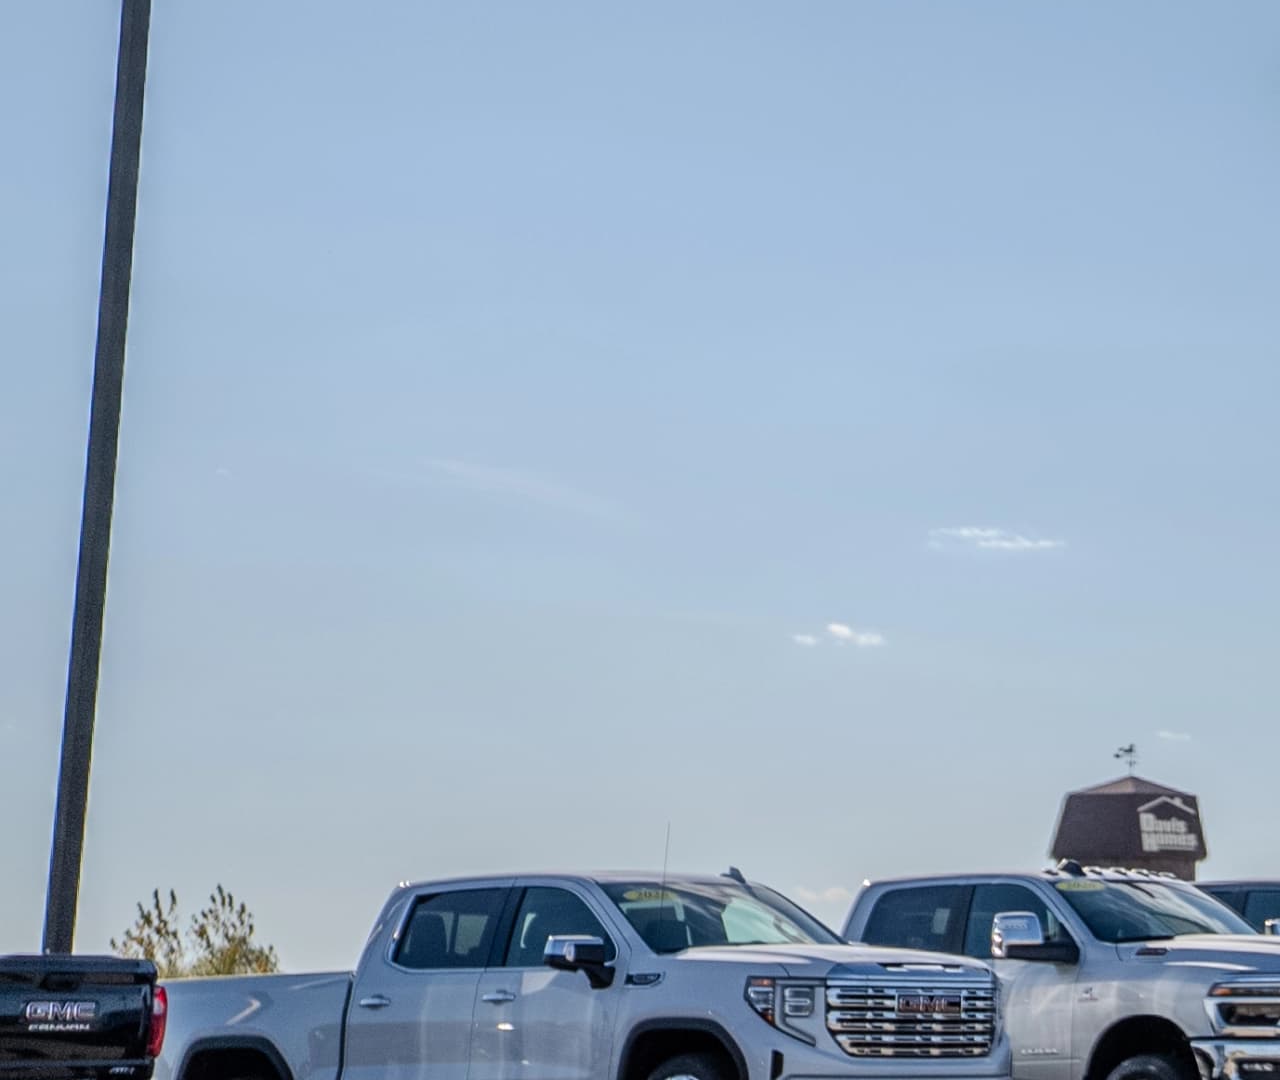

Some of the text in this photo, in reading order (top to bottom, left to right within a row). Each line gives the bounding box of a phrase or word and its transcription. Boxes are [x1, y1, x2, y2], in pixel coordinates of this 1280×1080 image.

[1139, 813, 1187, 832] Davis
[1142, 832, 1198, 852] Homes
[25, 1001, 97, 1021] GMC
[899, 995, 961, 1012] GMC
